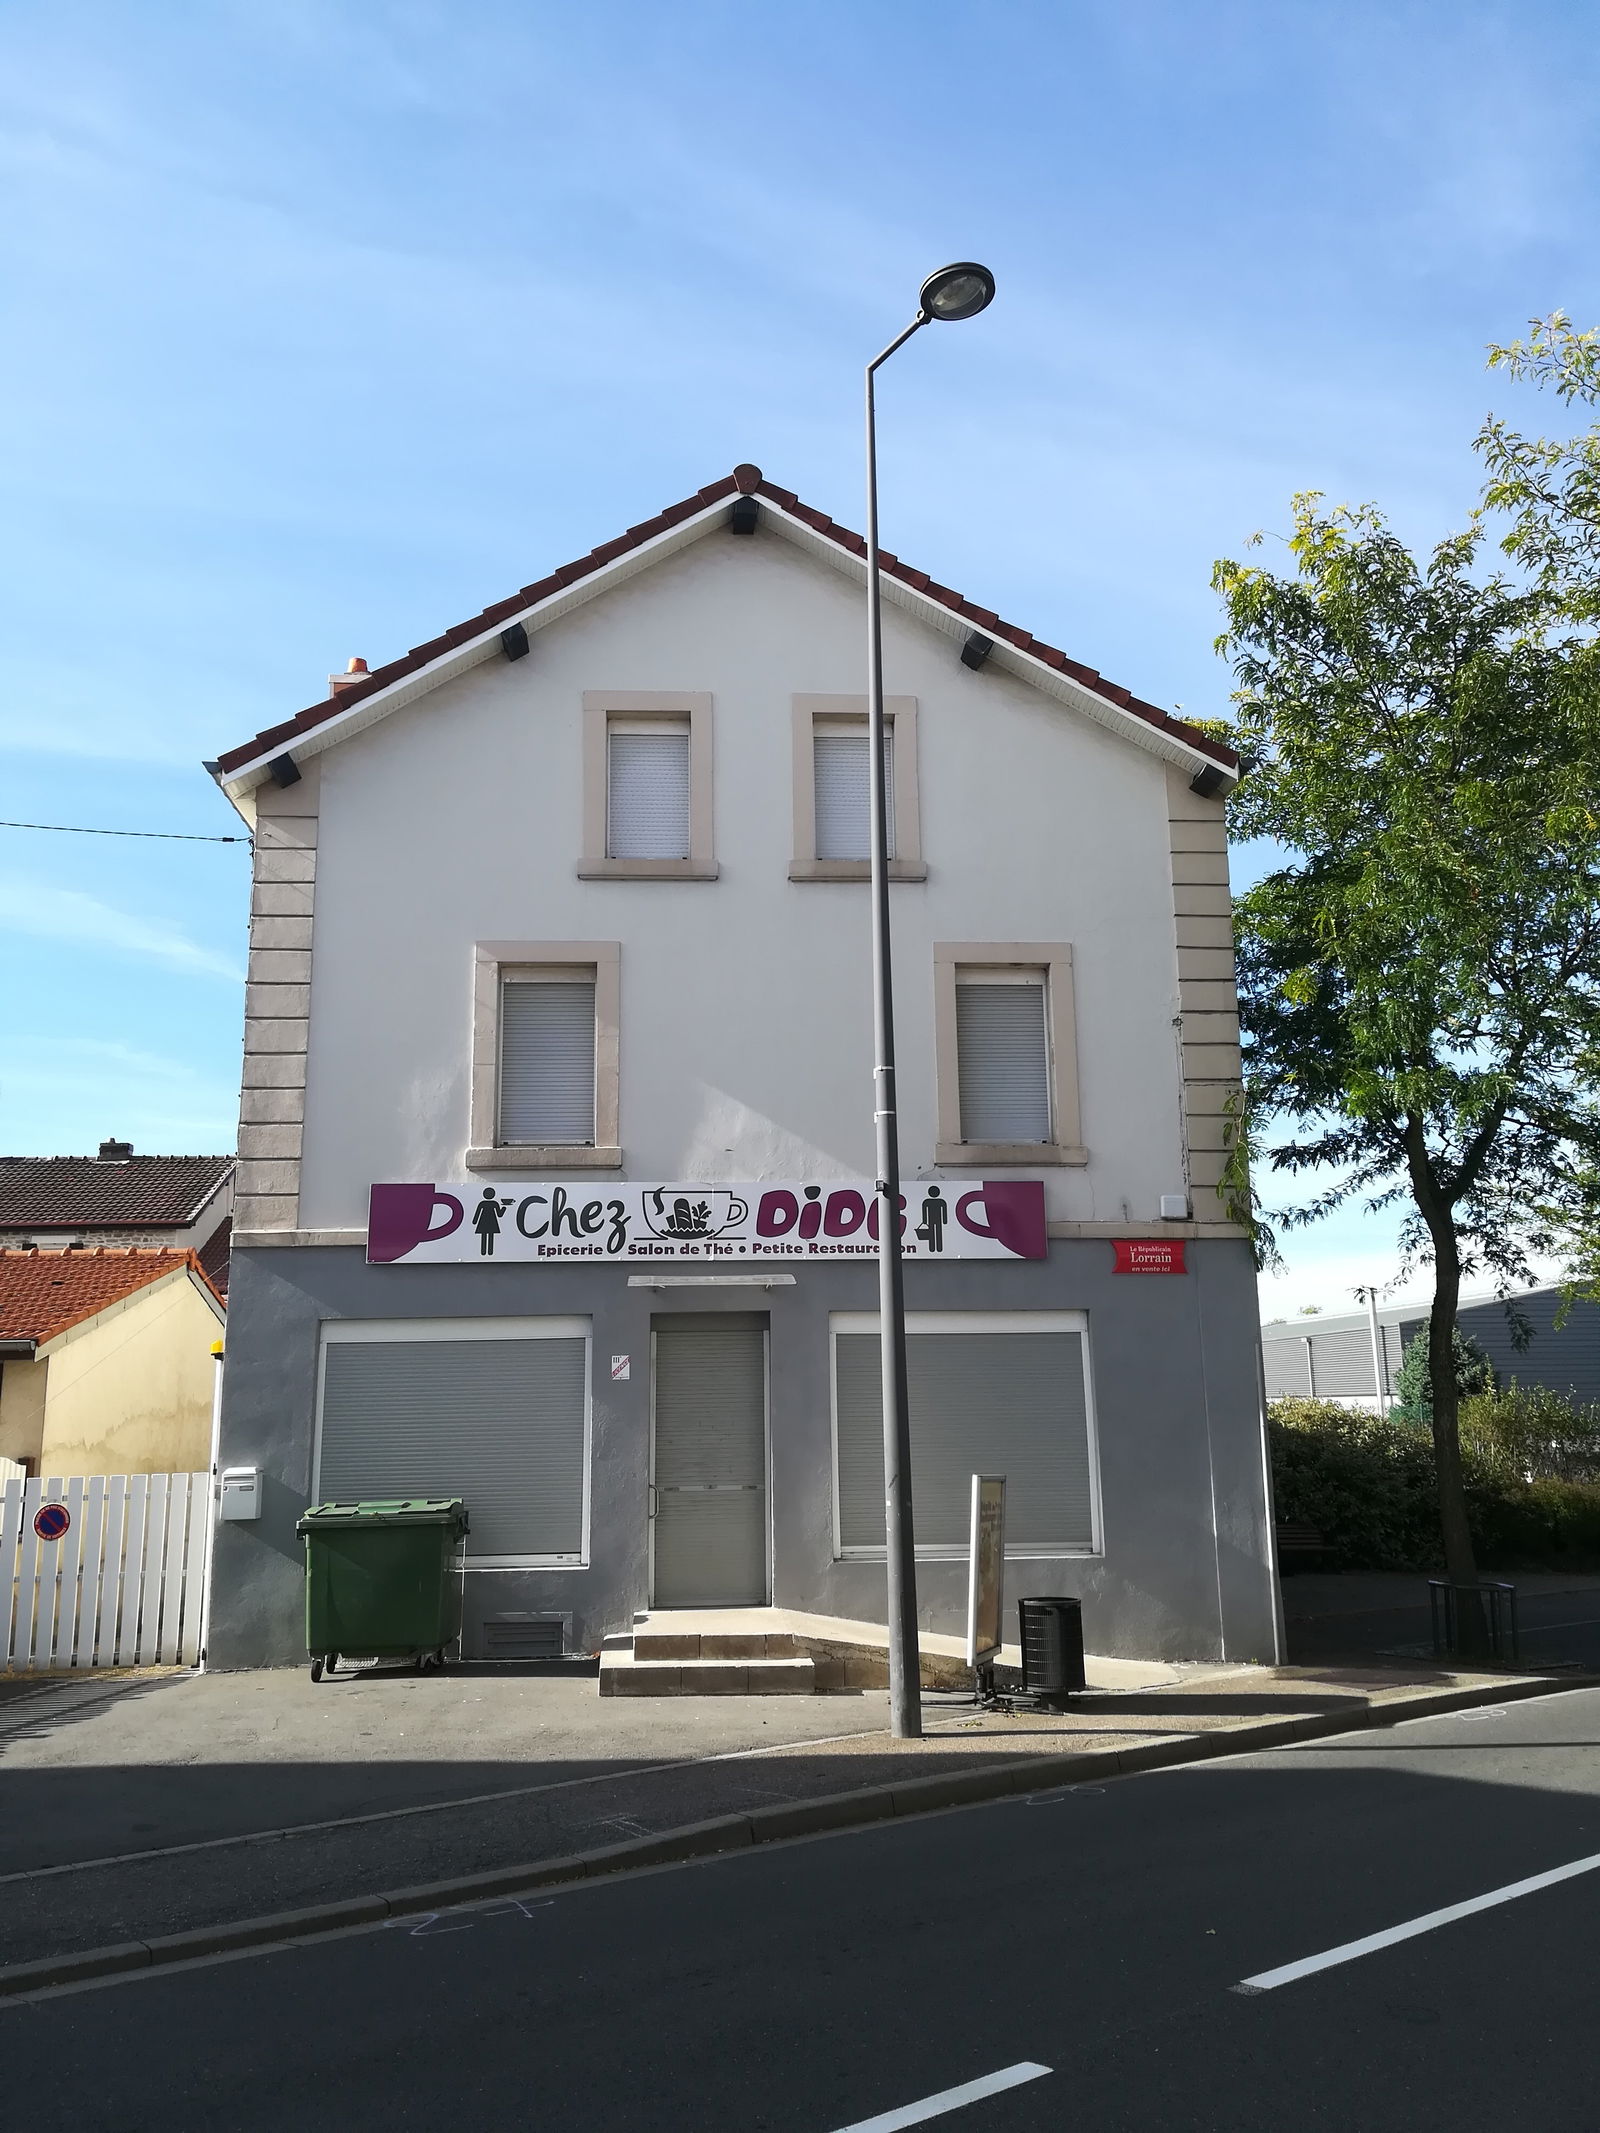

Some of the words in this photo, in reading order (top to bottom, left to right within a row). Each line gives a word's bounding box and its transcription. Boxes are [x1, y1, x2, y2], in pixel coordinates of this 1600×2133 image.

[516, 1187, 632, 1254] Chez
[538, 1244, 603, 1257] Epicerie
[628, 1243, 675, 1255] Salon
[680, 1243, 699, 1255] de
[704, 1243, 733, 1255] Thé
[752, 1243, 803, 1254] Petite
[1131, 1252, 1171, 1263] Lorrain
